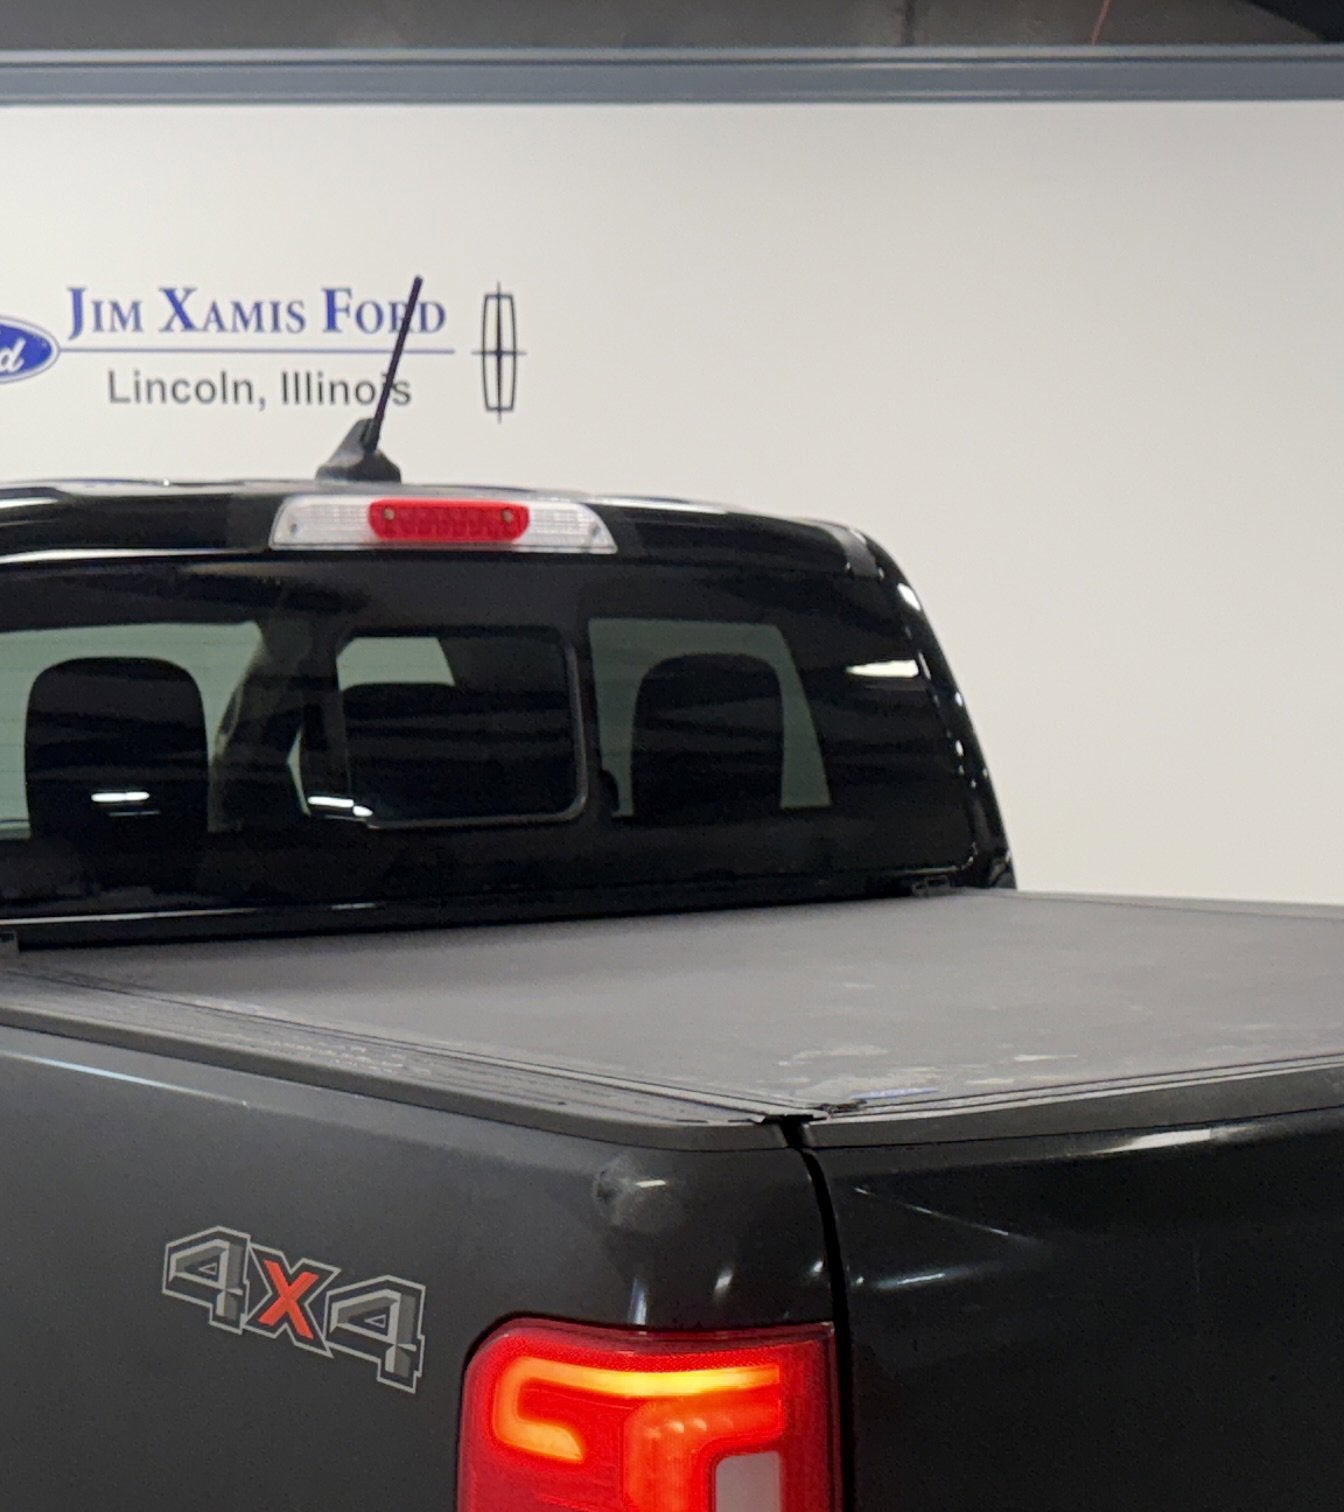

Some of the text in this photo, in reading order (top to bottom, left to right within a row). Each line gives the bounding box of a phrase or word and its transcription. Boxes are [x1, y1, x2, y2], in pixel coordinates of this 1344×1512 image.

[67, 287, 142, 341] JIM
[158, 287, 307, 334] XAMIS
[107, 370, 266, 412] Lincoln,
